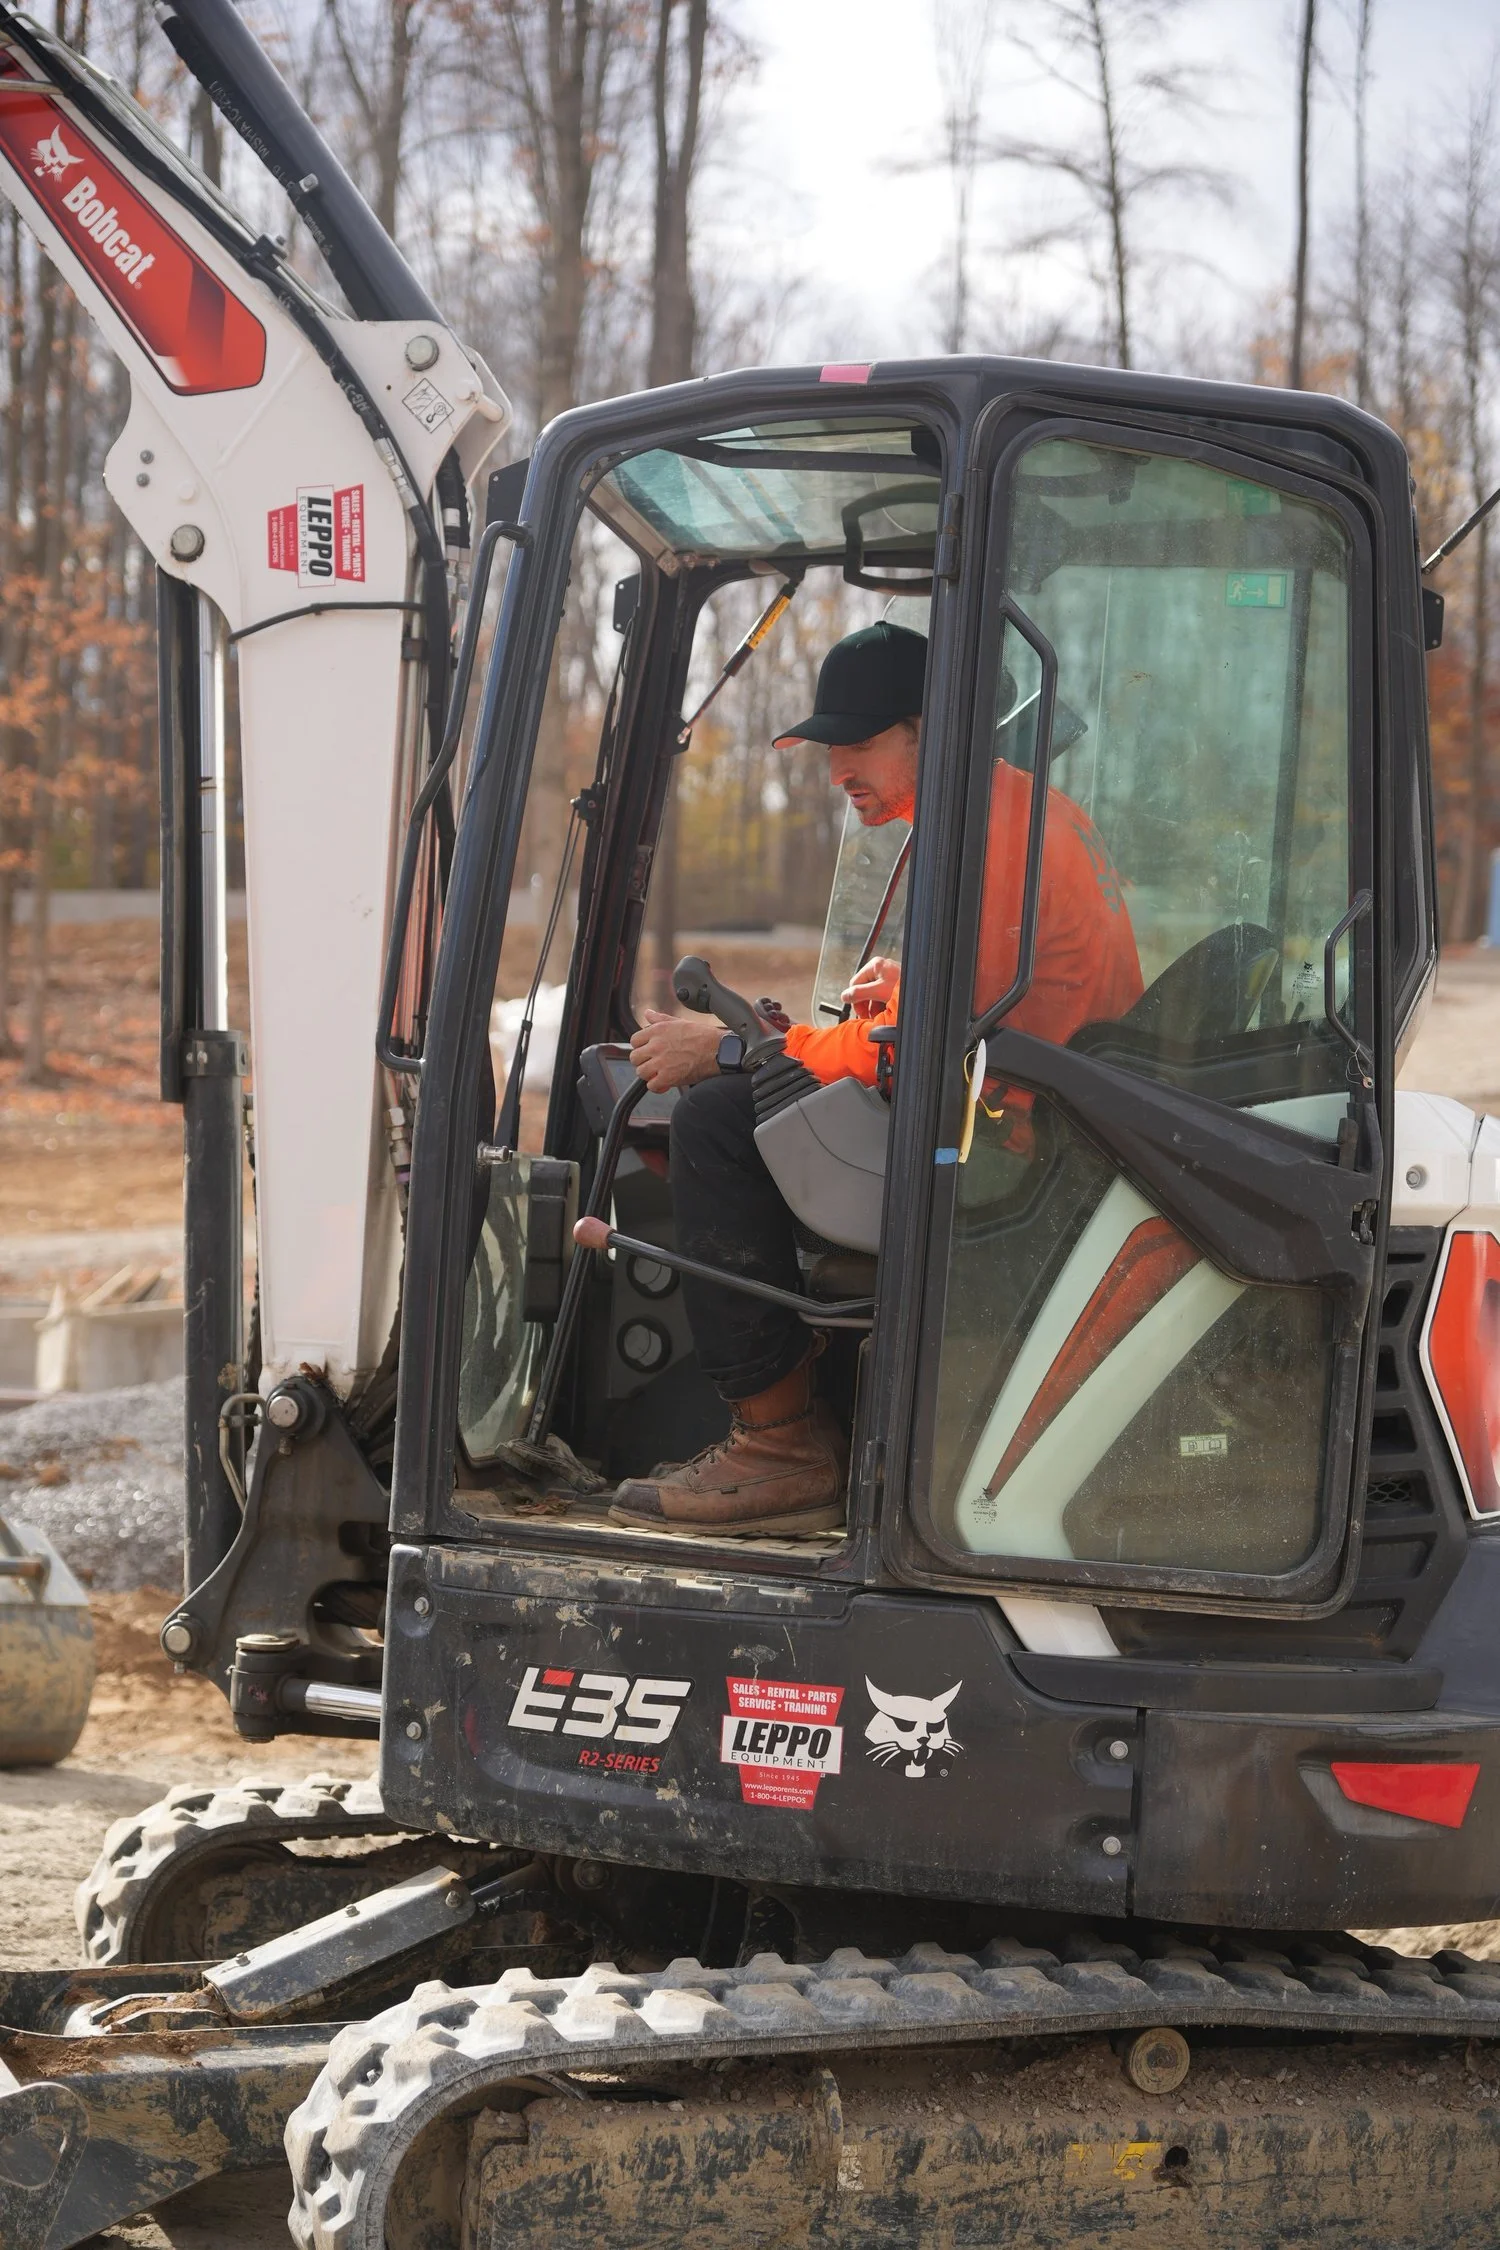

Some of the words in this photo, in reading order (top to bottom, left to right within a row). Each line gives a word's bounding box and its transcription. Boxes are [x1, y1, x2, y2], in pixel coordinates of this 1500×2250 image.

[62, 176, 155, 284] Bobcat
[341, 496, 350, 528] SERVICE
[351, 490, 360, 513] SALES
[300, 496, 308, 575] EQUIPMENT
[307, 496, 333, 577] LEPPO
[352, 519, 360, 547] RENTAL
[342, 534, 351, 571] TRAINING
[352, 553, 361, 578] PARTS
[508, 1667, 691, 1744] E35
[733, 1683, 760, 1695] SALES
[768, 1687, 800, 1699] RENTAL
[808, 1690, 837, 1703] PARTS
[738, 1697, 776, 1711] SERVICE
[784, 1701, 827, 1715] TRAINING
[732, 1720, 832, 1759] LEPPO
[578, 1750, 661, 1773] R2-SERIES
[731, 1752, 826, 1769] EQUIPMENT
[759, 1772, 779, 1780] Since
[744, 1783, 814, 1796] www.lepporents.com
[750, 1792, 806, 1804] 1-800-4-LEPPOS
